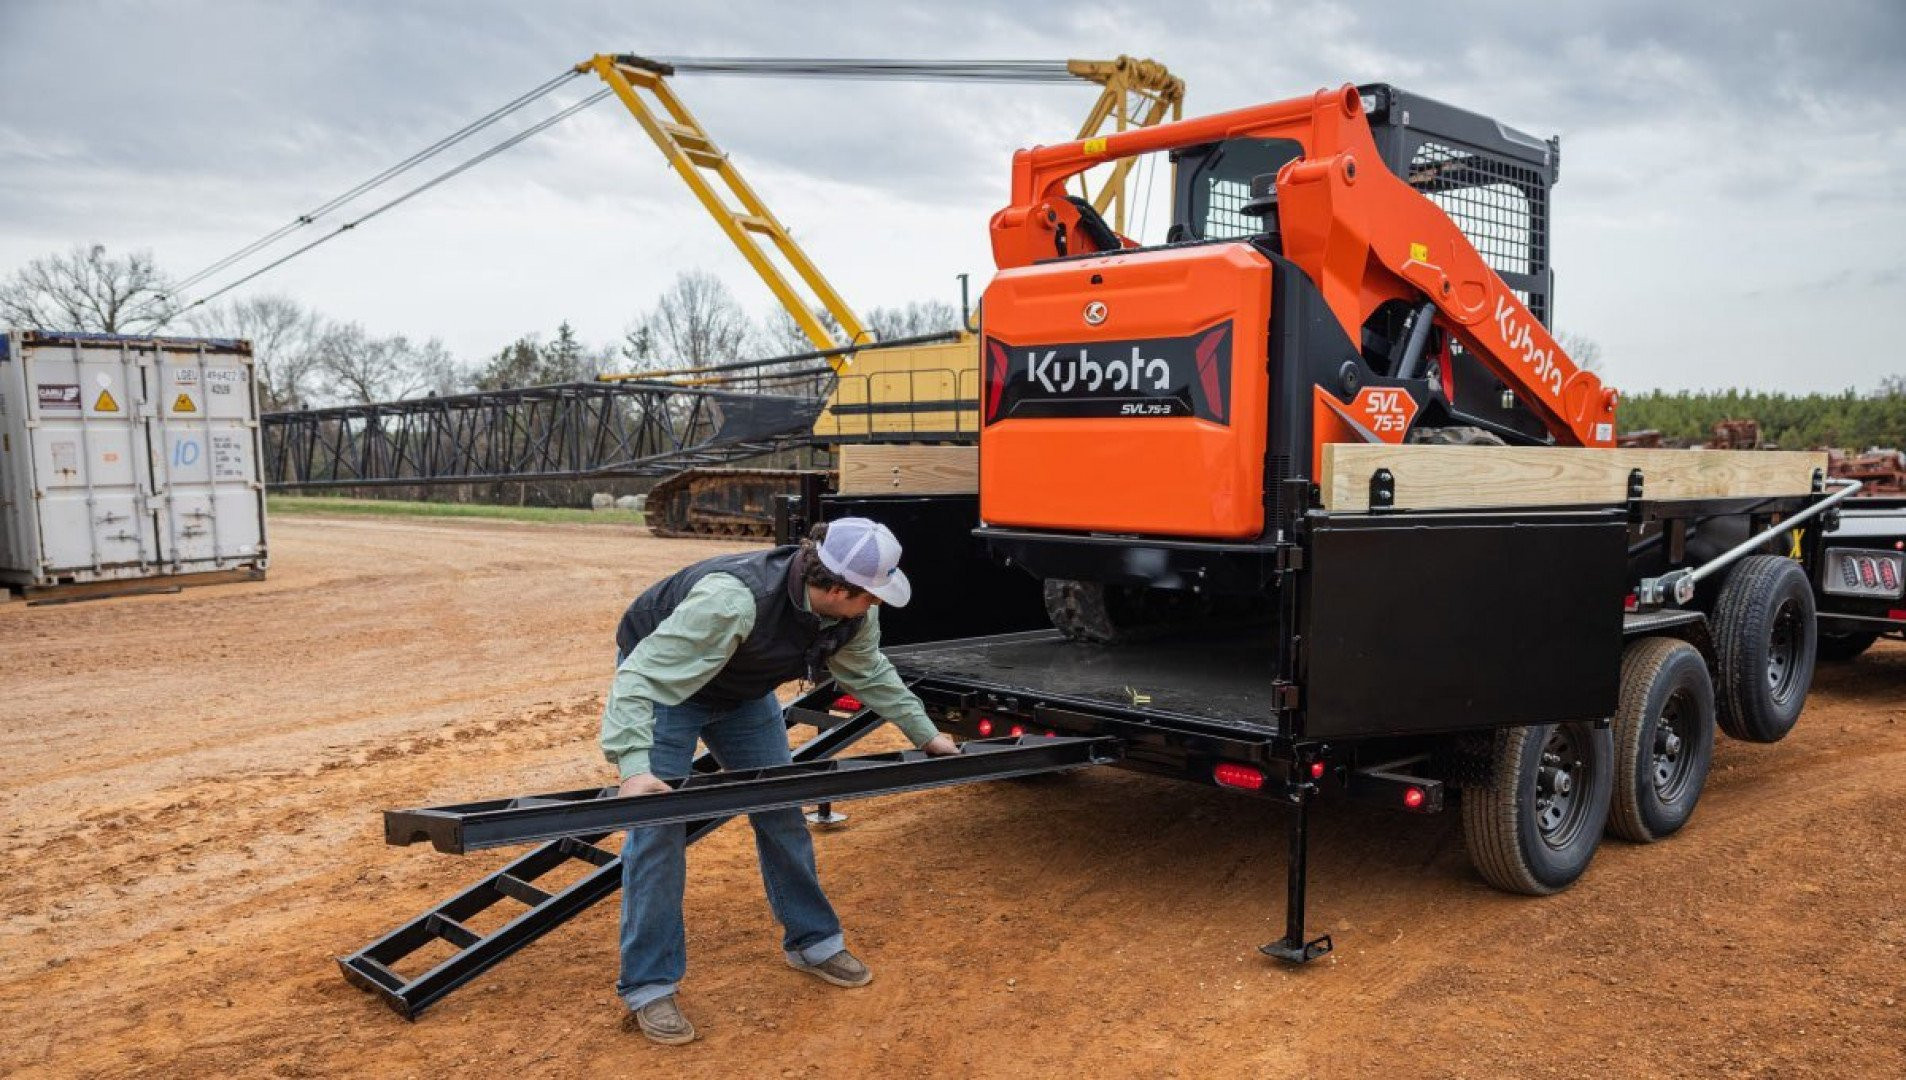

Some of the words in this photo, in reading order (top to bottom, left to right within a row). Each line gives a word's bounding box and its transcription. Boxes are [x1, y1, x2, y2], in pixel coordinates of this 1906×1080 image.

[1495, 294, 1562, 397] Kubota
[1028, 347, 1170, 393] Kubota
[1365, 391, 1404, 413] SVL
[1373, 414, 1405, 431] 75-3
[173, 439, 200, 467] 10
